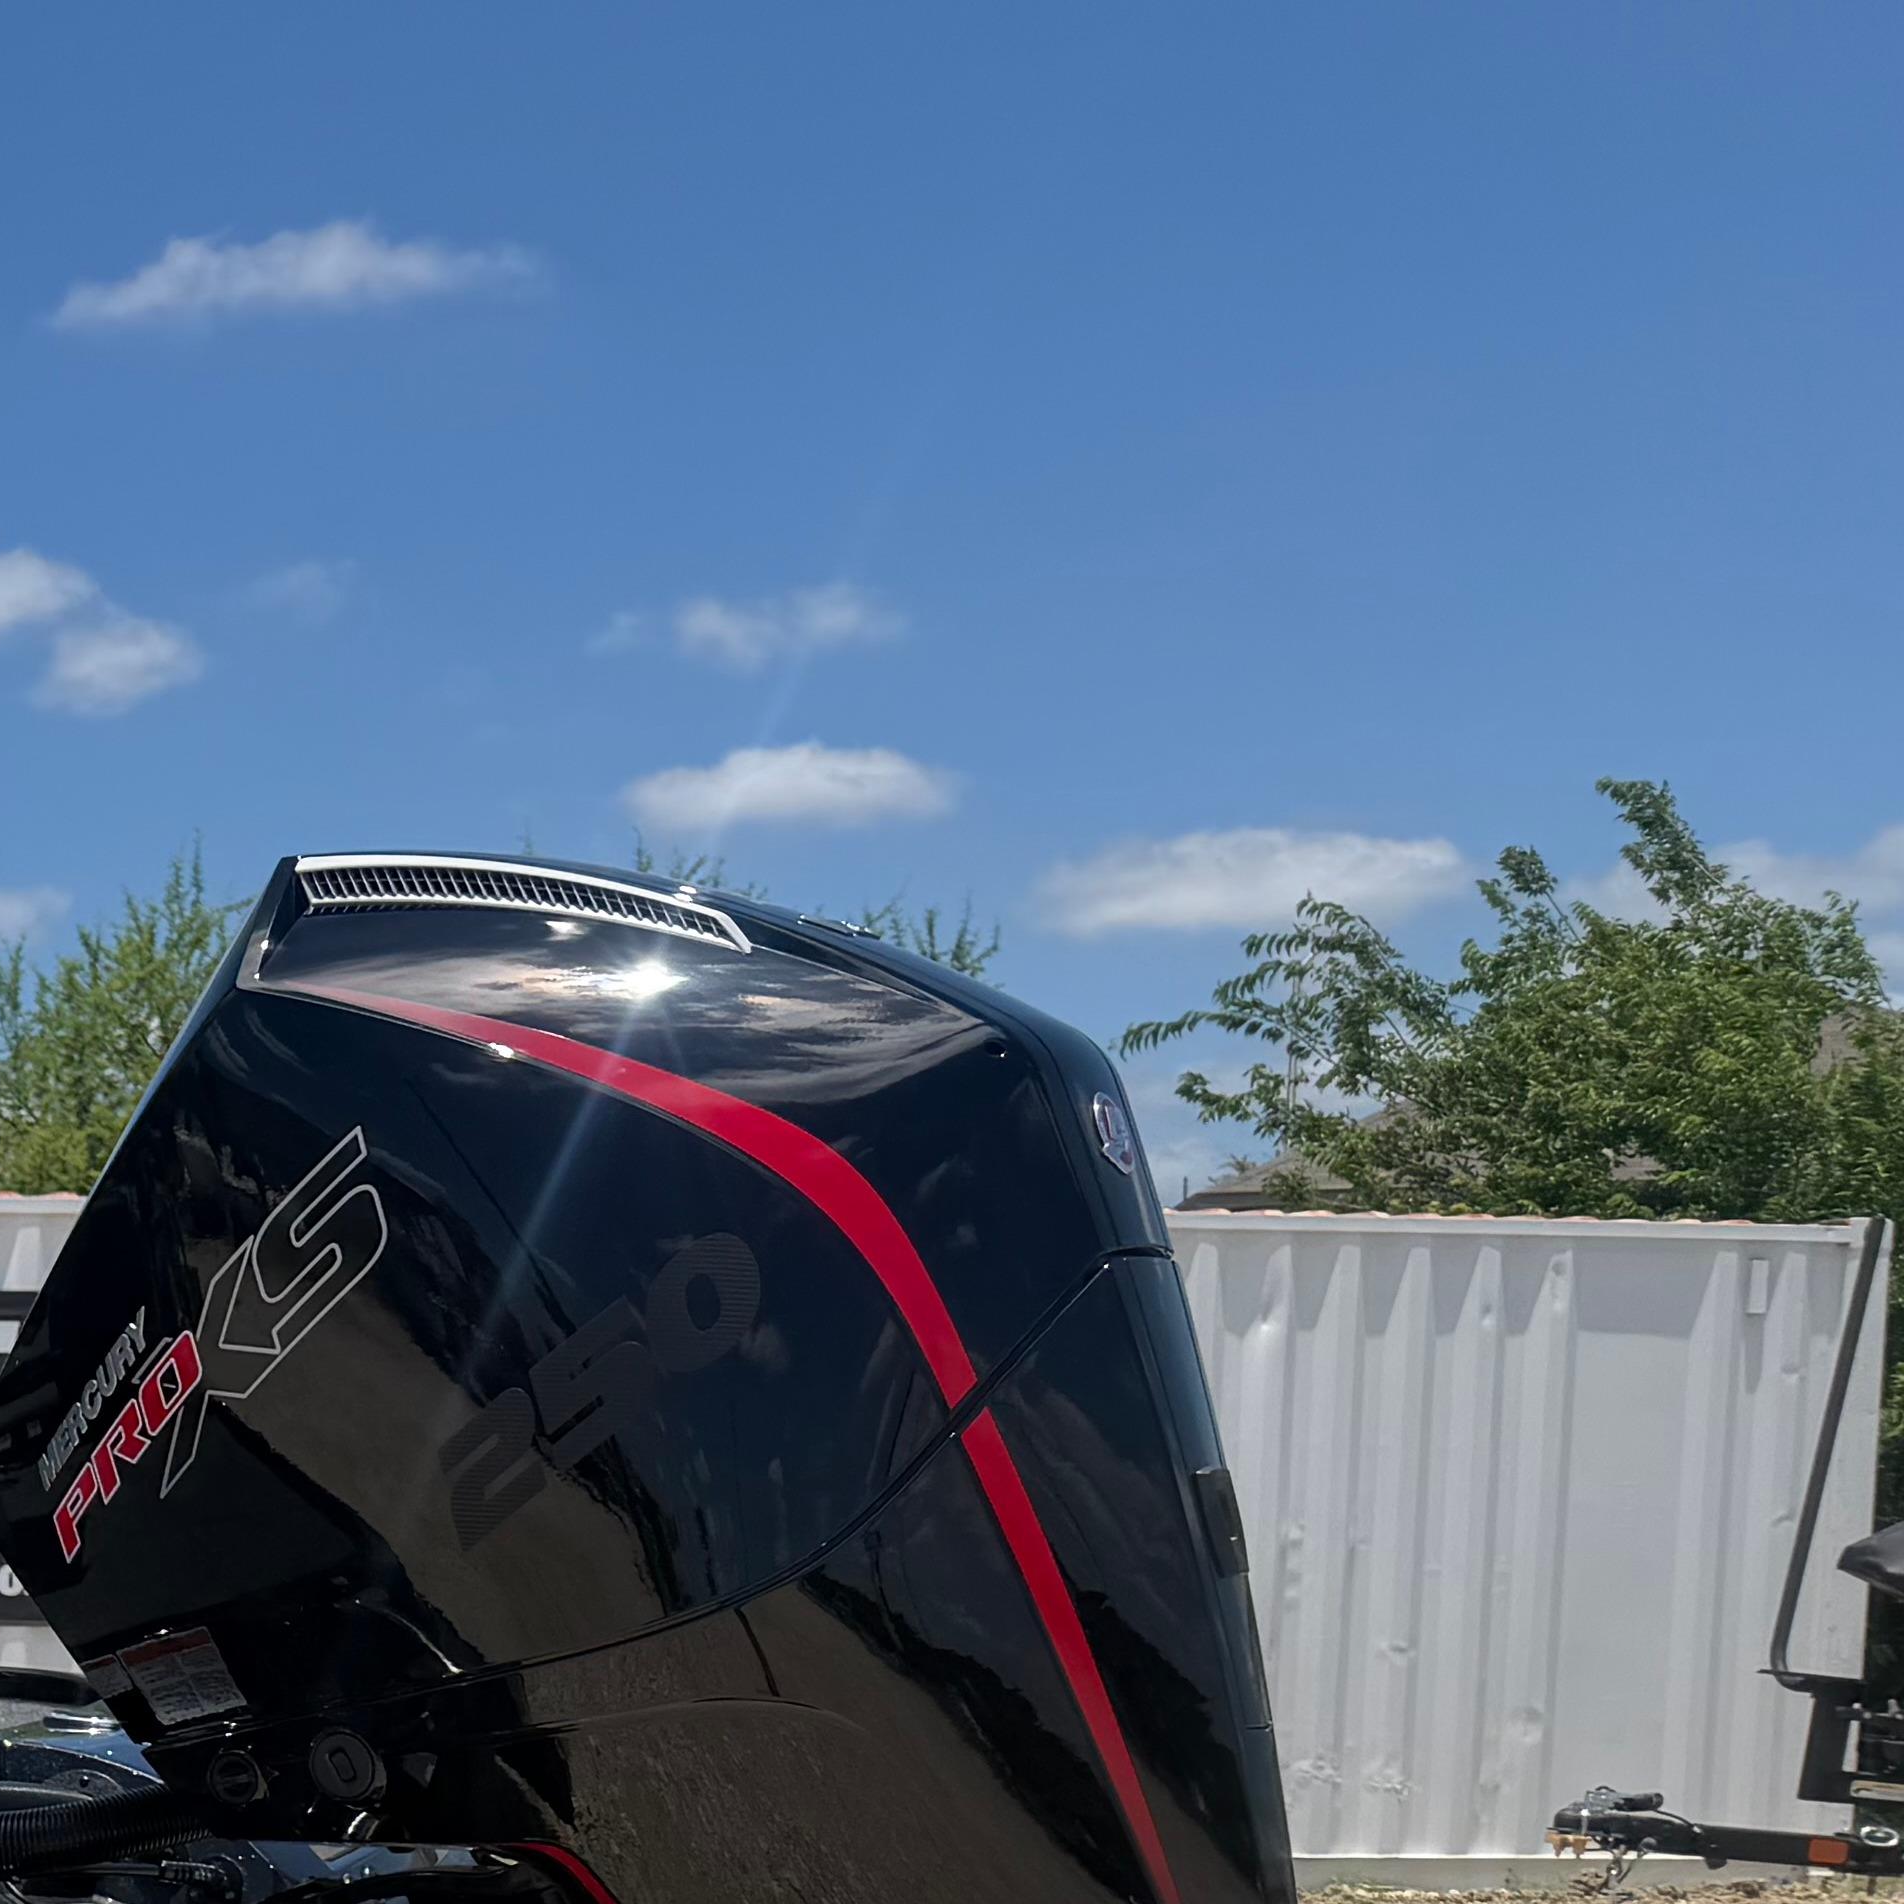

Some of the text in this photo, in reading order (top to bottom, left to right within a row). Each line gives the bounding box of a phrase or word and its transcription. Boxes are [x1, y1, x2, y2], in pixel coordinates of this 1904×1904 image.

[36, 1305, 146, 1492] MERCURY
[53, 1329, 202, 1564] PRO
[134, 1125, 388, 1499] XS
[439, 1231, 761, 1551] 250
